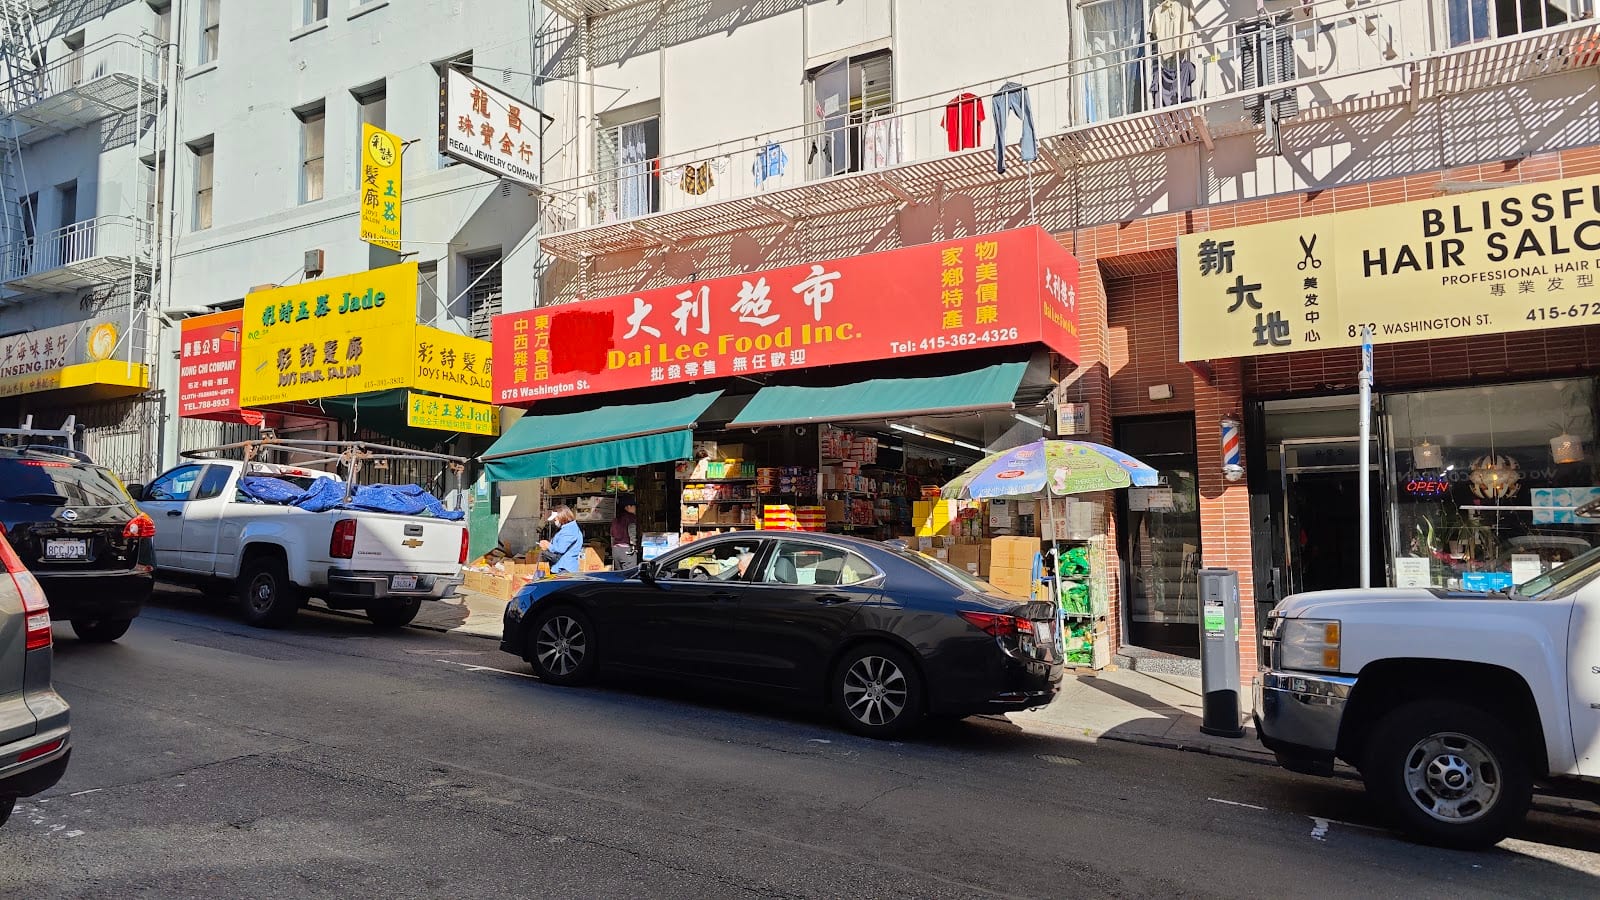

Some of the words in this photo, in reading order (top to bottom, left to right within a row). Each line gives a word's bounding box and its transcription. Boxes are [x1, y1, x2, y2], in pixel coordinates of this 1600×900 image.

[470, 86, 522, 133] 龍昌
[457, 113, 533, 165] 珠寶金行
[449, 138, 474, 156] REGAL
[474, 149, 505, 171] JEWELRY
[507, 164, 538, 183] COMPANY
[382, 180, 397, 222] 玉器
[1362, 238, 1466, 278] HAIR
[1486, 219, 1600, 262] SALO
[941, 246, 964, 330] 家鄉特產
[974, 240, 999, 325] 物美價廉
[1441, 265, 1549, 287] PROFESSIONAL
[1555, 260, 1589, 274] HAIR
[262, 293, 332, 328] 彩詩玉器
[338, 287, 386, 314] Jade
[623, 264, 842, 341] 大利超市
[1303, 276, 1321, 342] 美发中心
[1526, 302, 1600, 321] 415-672
[890, 341, 916, 354] Tel:
[918, 326, 1019, 352] 415-362-4326
[1382, 315, 1471, 336] WASHINGTON
[1476, 313, 1493, 326] ST.
[209, 359, 236, 373] COMPANY
[513, 318, 529, 384] 中西雜貨
[533, 314, 550, 381] 東方食品
[607, 344, 652, 370] Dai
[658, 340, 709, 364] Lee
[717, 326, 792, 356] Food
[801, 321, 863, 346] Inc.
[650, 360, 717, 382] 批發零售
[732, 348, 807, 372] 無任歡迎
[299, 368, 325, 384] HAIR
[327, 364, 362, 381] SALON
[417, 365, 440, 380] JOY'S
[442, 370, 468, 385] HAIR
[501, 389, 518, 400] 878
[519, 381, 574, 398] Washington
[576, 379, 590, 391] St.
[466, 406, 497, 424] Jade
[1406, 481, 1449, 492] OPEN
[48, 545, 85, 555] 8CCJ913
